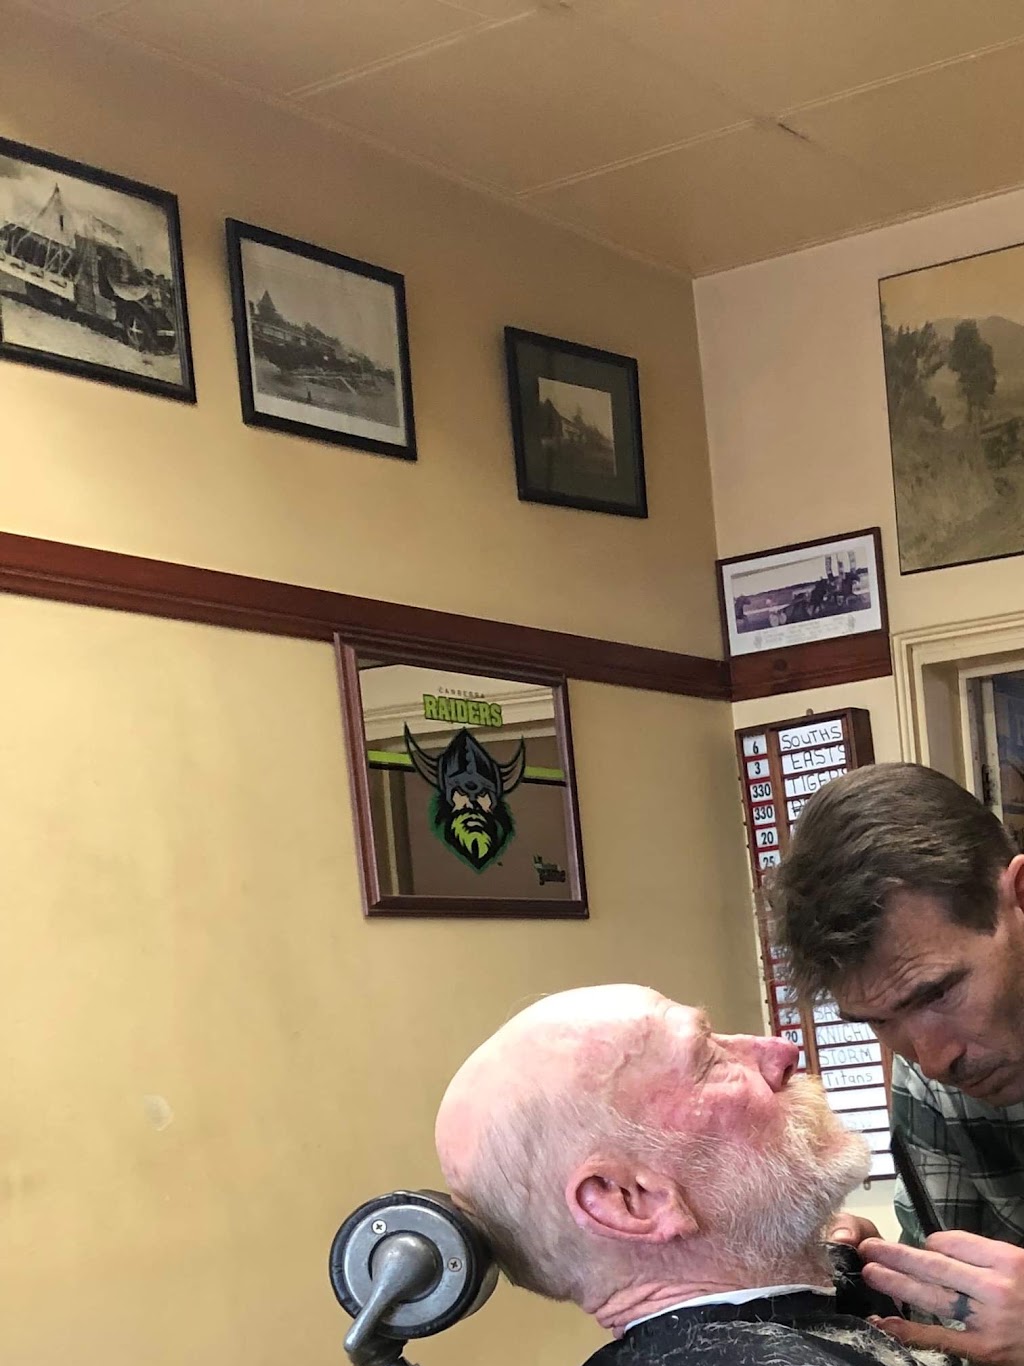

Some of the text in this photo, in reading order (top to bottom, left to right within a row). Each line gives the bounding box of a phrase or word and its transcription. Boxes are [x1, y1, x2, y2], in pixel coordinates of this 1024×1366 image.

[423, 694, 503, 727] RAIDERS
[752, 726, 842, 754] 6 SOUTHS
[755, 745, 846, 775] 3 EASTS
[752, 784, 771, 799] 330
[755, 806, 773, 821] 330
[761, 832, 774, 845] 20
[817, 1024, 871, 1044] KNIGHT
[819, 1048, 873, 1065] STORM
[824, 1069, 873, 1087] Titans
